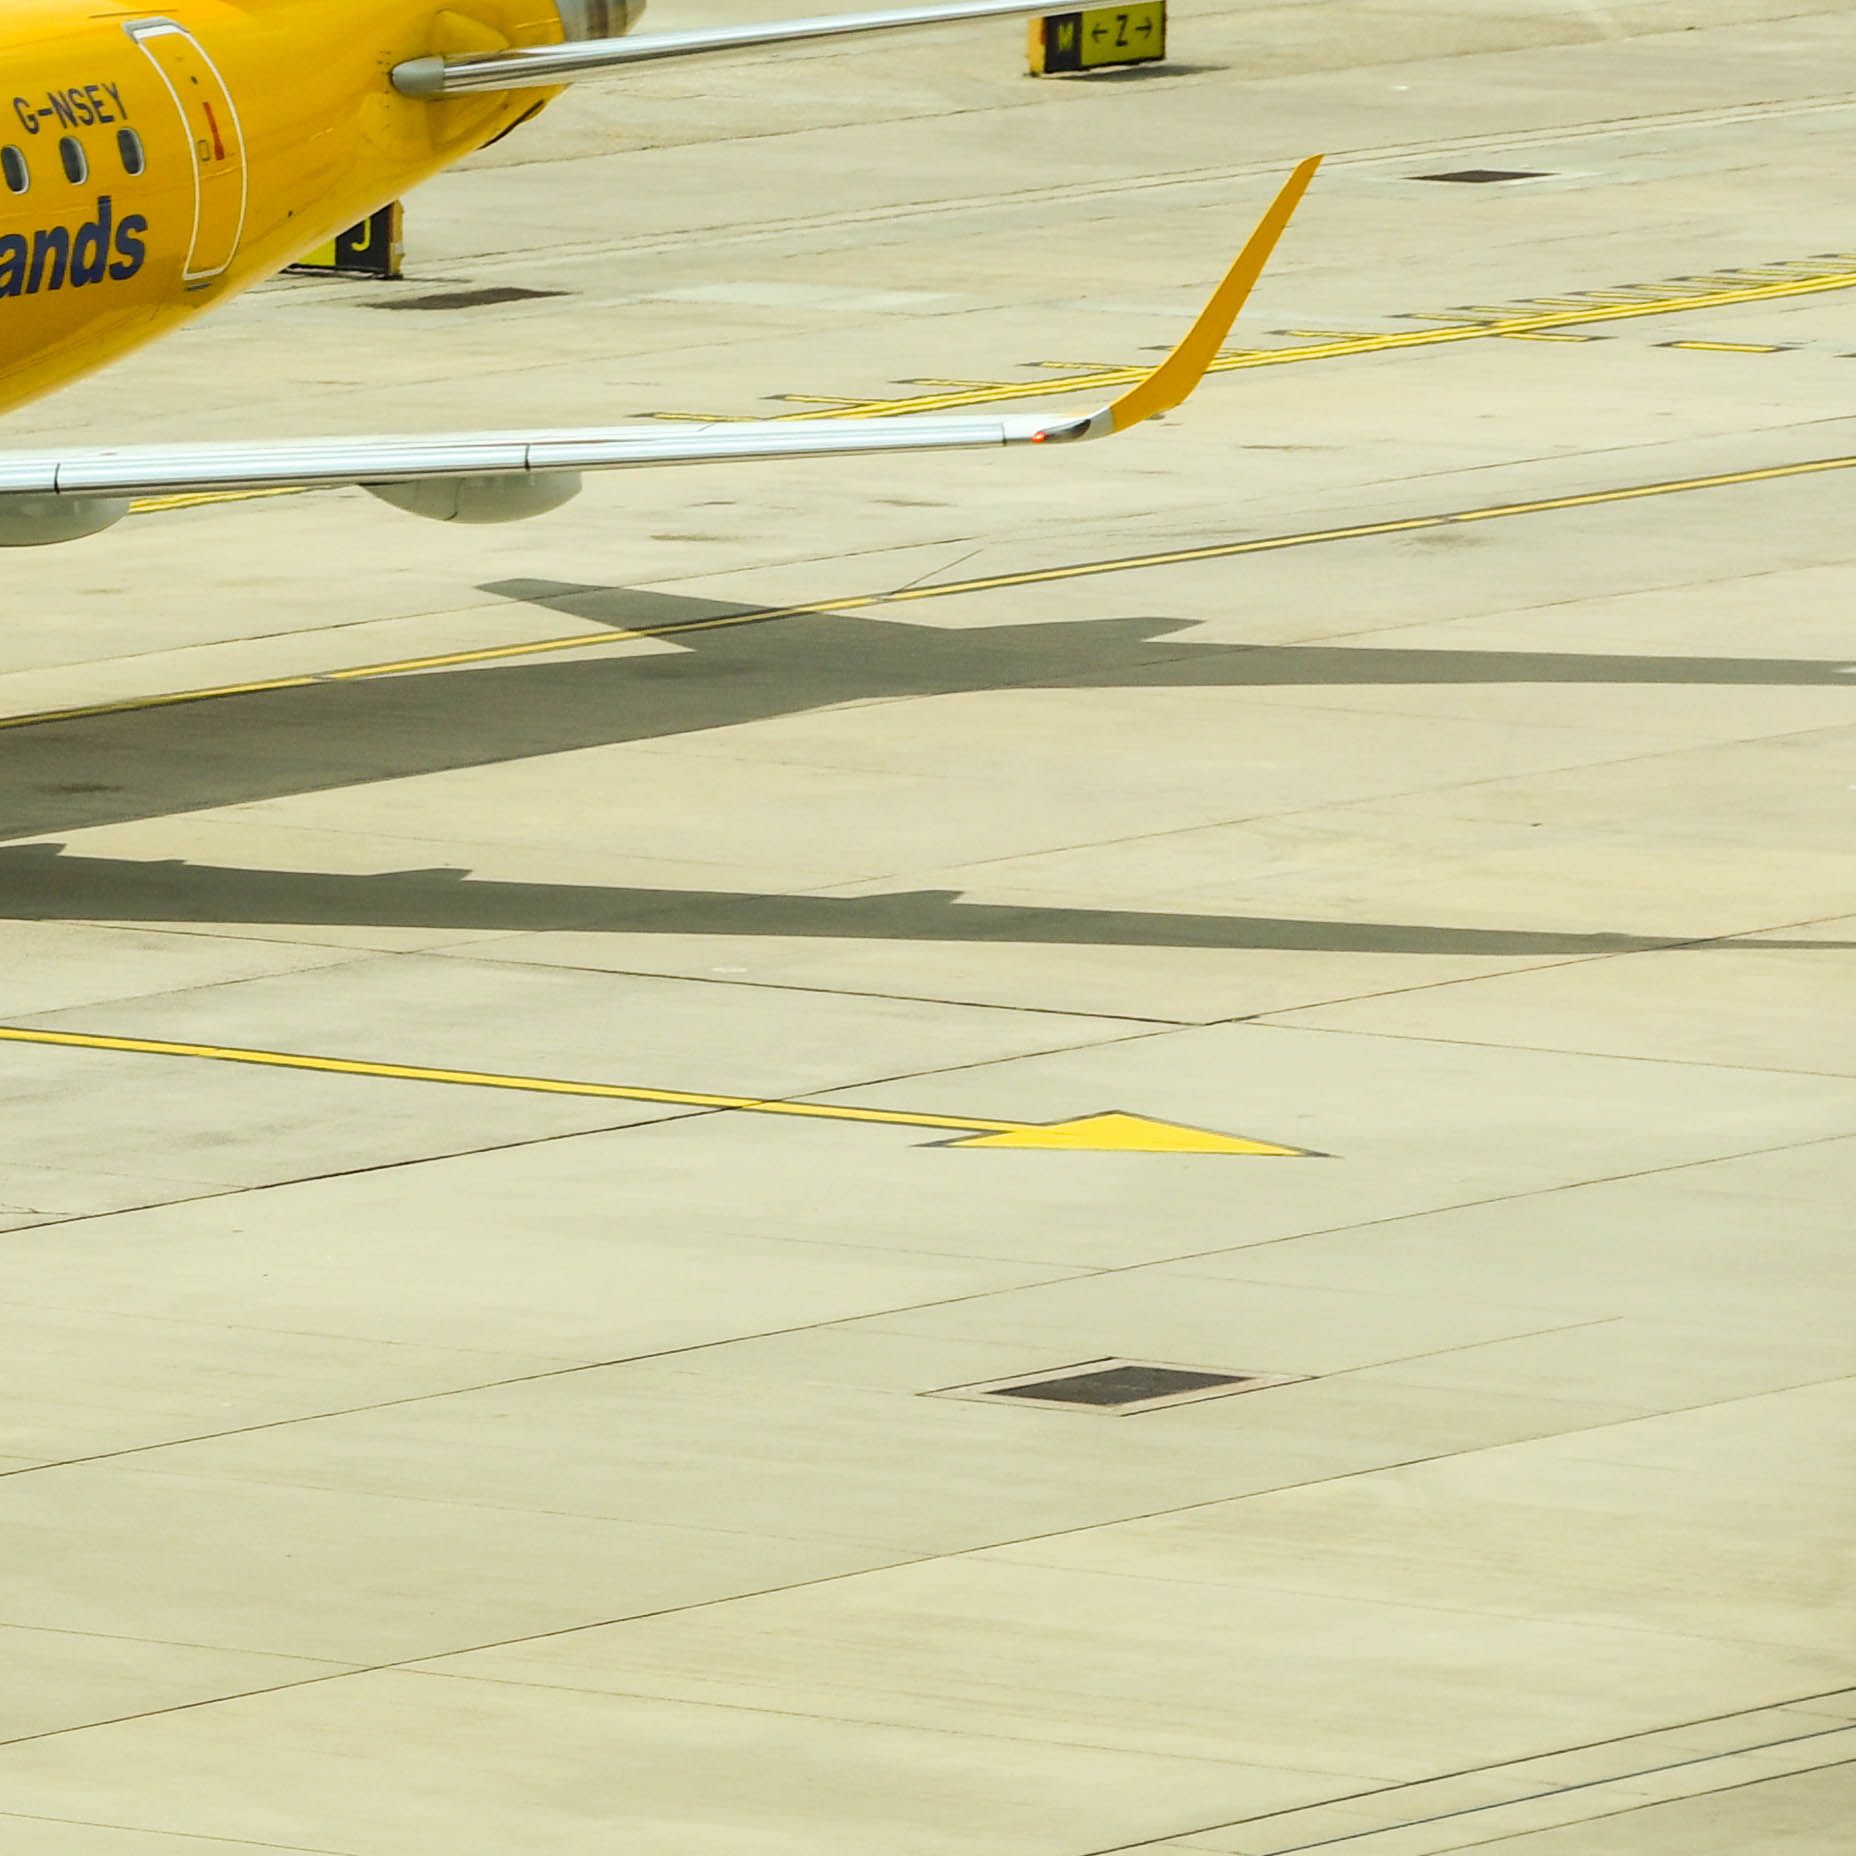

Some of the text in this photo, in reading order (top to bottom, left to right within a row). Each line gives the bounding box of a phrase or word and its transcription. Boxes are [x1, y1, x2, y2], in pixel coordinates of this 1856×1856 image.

[1056, 14, 1129, 52] M Z
[12, 81, 128, 135] G-NSEY
